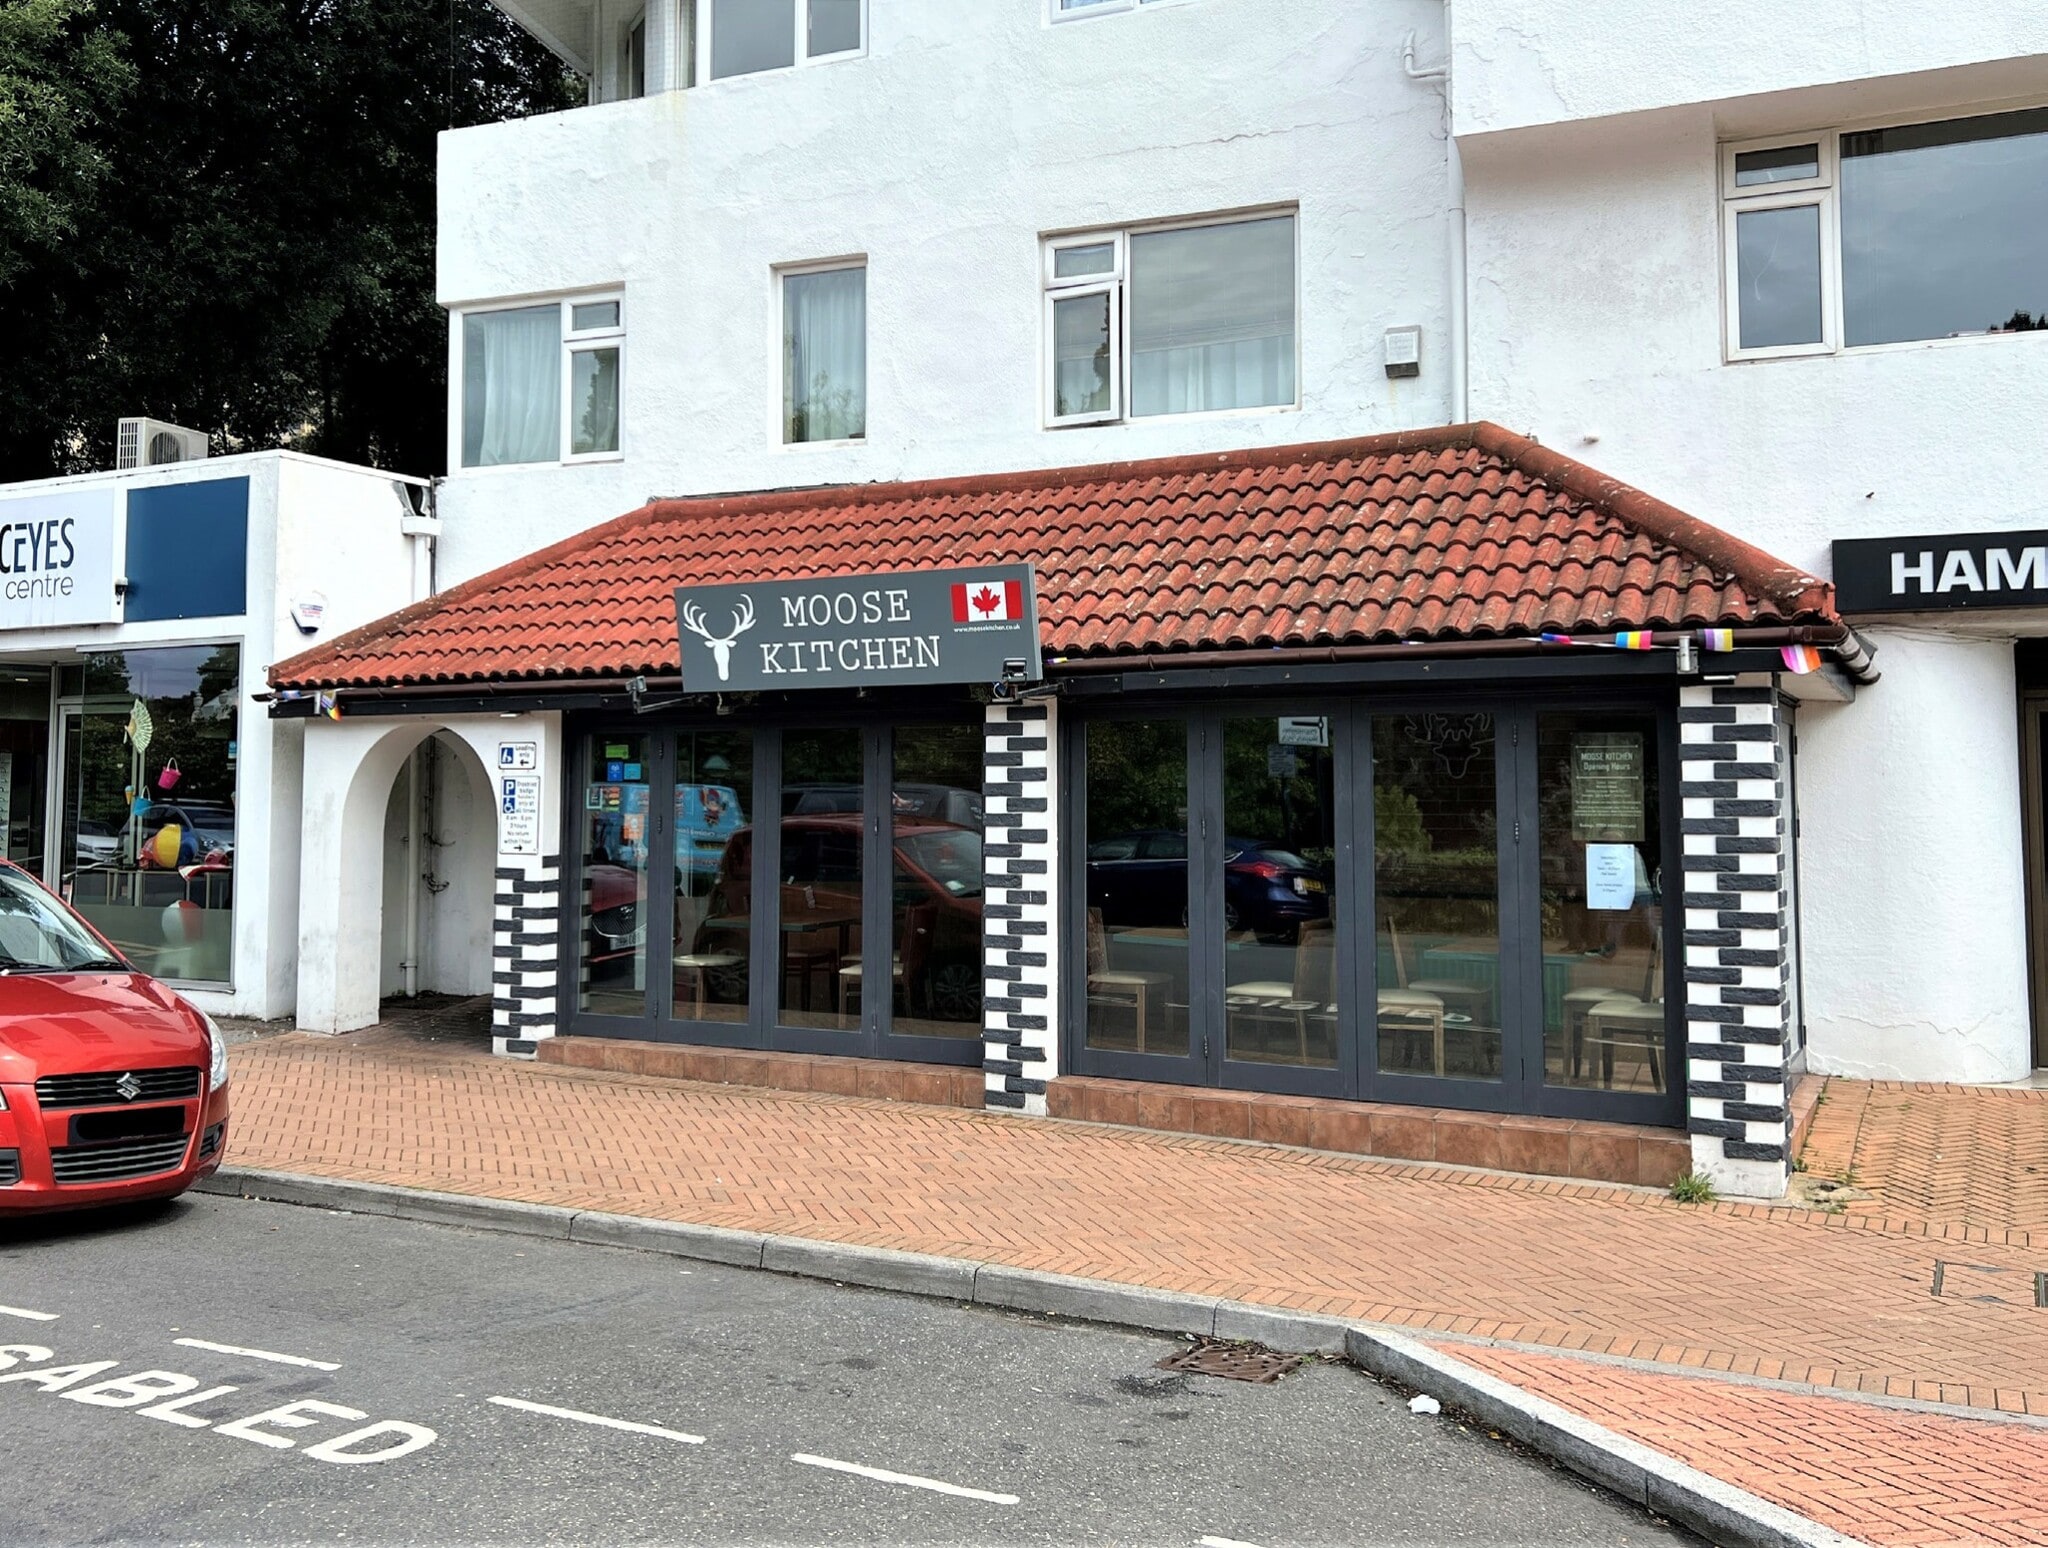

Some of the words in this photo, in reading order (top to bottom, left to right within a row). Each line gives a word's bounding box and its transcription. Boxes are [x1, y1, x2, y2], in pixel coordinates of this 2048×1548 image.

[1890, 547, 2048, 595] HAM
[5, 573, 74, 600] centre
[781, 589, 912, 628] MOOSE
[953, 623, 1021, 633] www.moosekitchen.co.uk
[760, 635, 941, 674] KITCHEN
[1580, 752, 1603, 761] MOOSE
[1605, 751, 1633, 760] KITCHEN
[1583, 761, 1610, 772] Opening
[1610, 761, 1631, 770] Hours
[506, 781, 514, 794] P
